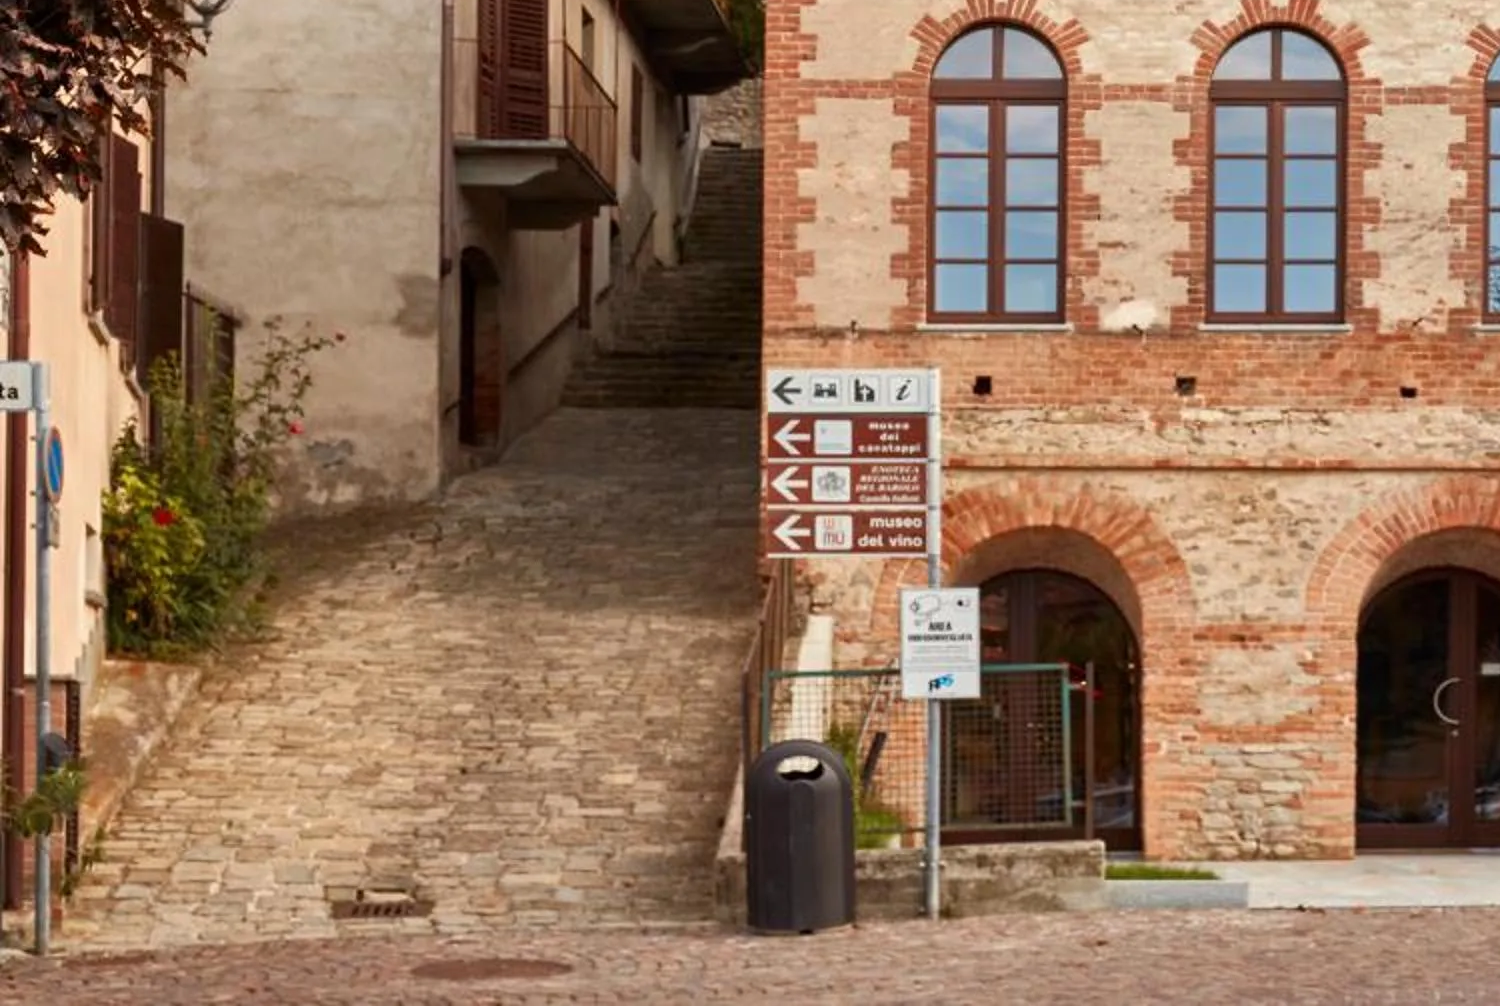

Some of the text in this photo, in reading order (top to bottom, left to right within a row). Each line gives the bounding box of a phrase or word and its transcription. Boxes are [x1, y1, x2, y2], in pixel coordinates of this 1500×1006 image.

[868, 422, 910, 431] museo
[869, 517, 923, 528] museo
[857, 534, 923, 547] del vino
